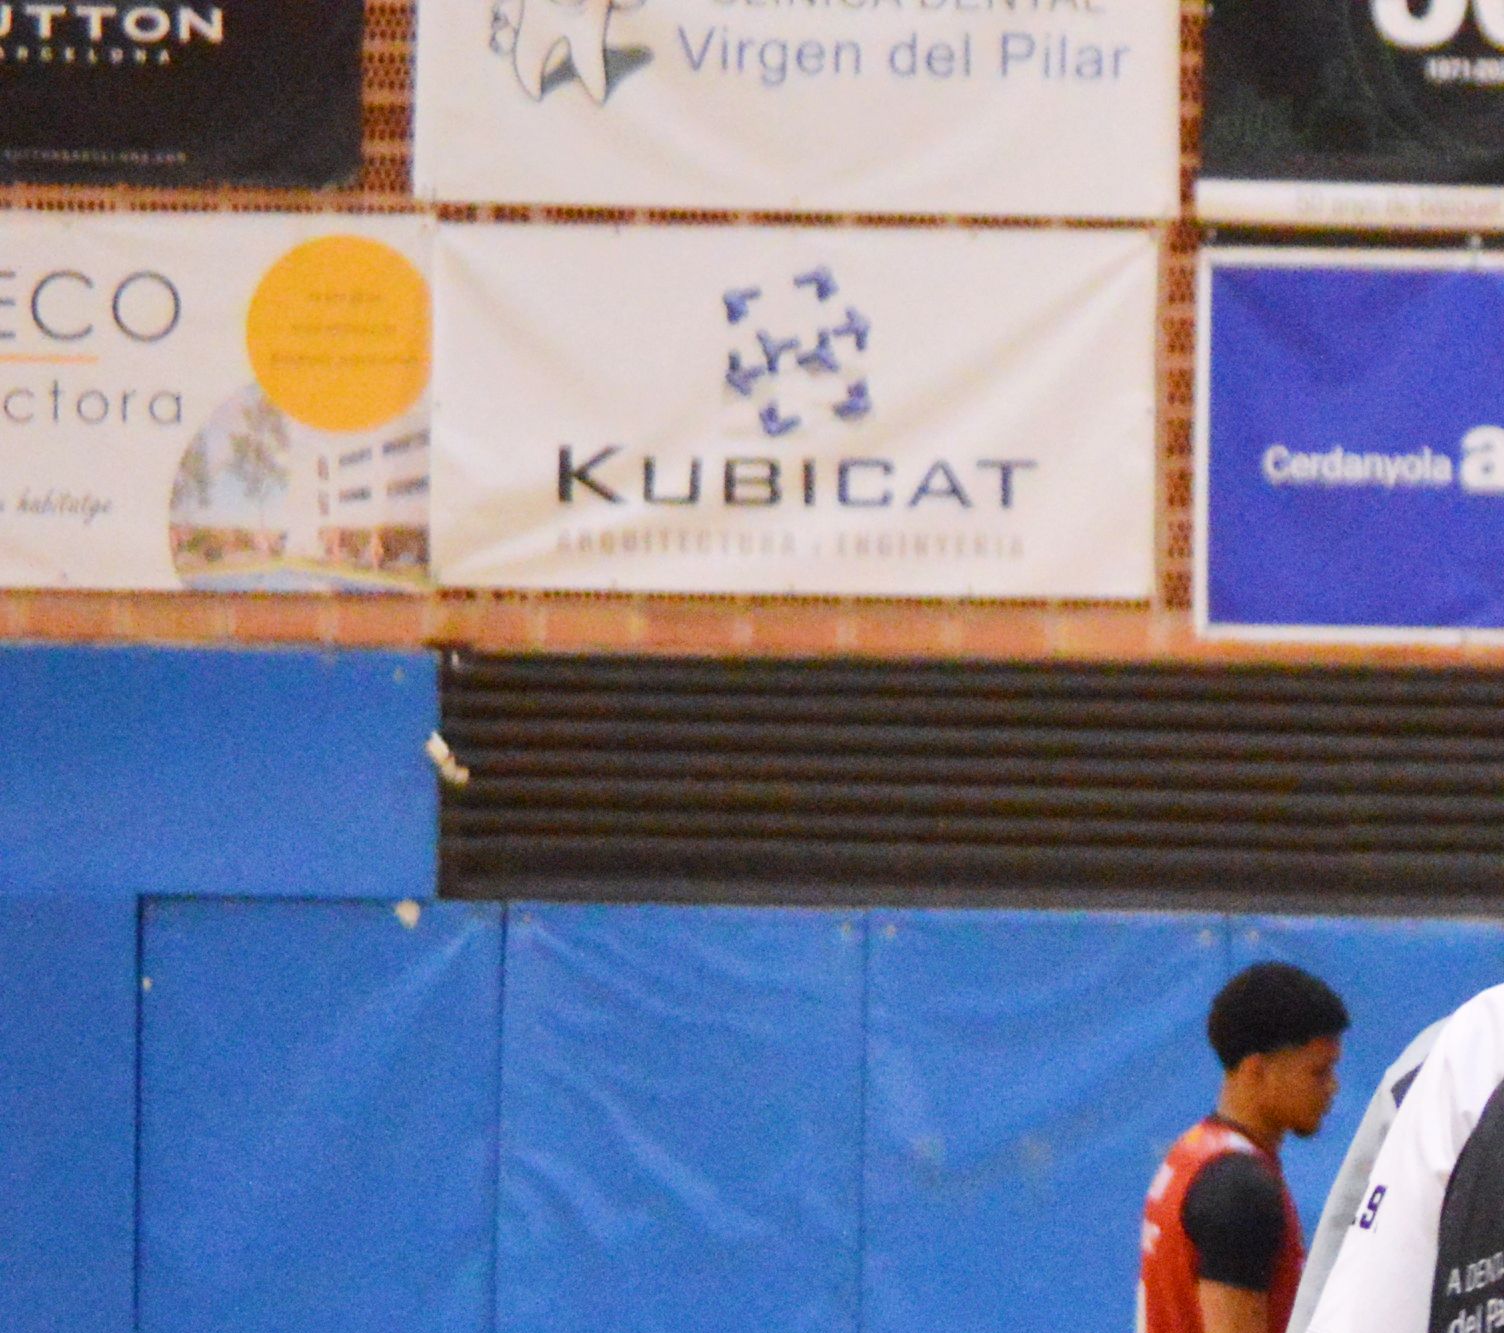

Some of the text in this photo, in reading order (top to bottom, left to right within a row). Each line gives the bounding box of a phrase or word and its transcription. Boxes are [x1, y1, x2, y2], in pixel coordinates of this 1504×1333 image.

[0, 4, 224, 44] TTON
[0, 46, 171, 65] RCELONA
[676, 25, 1130, 88] Virgen del Pilar
[1262, 444, 1454, 488] Cerdanyola
